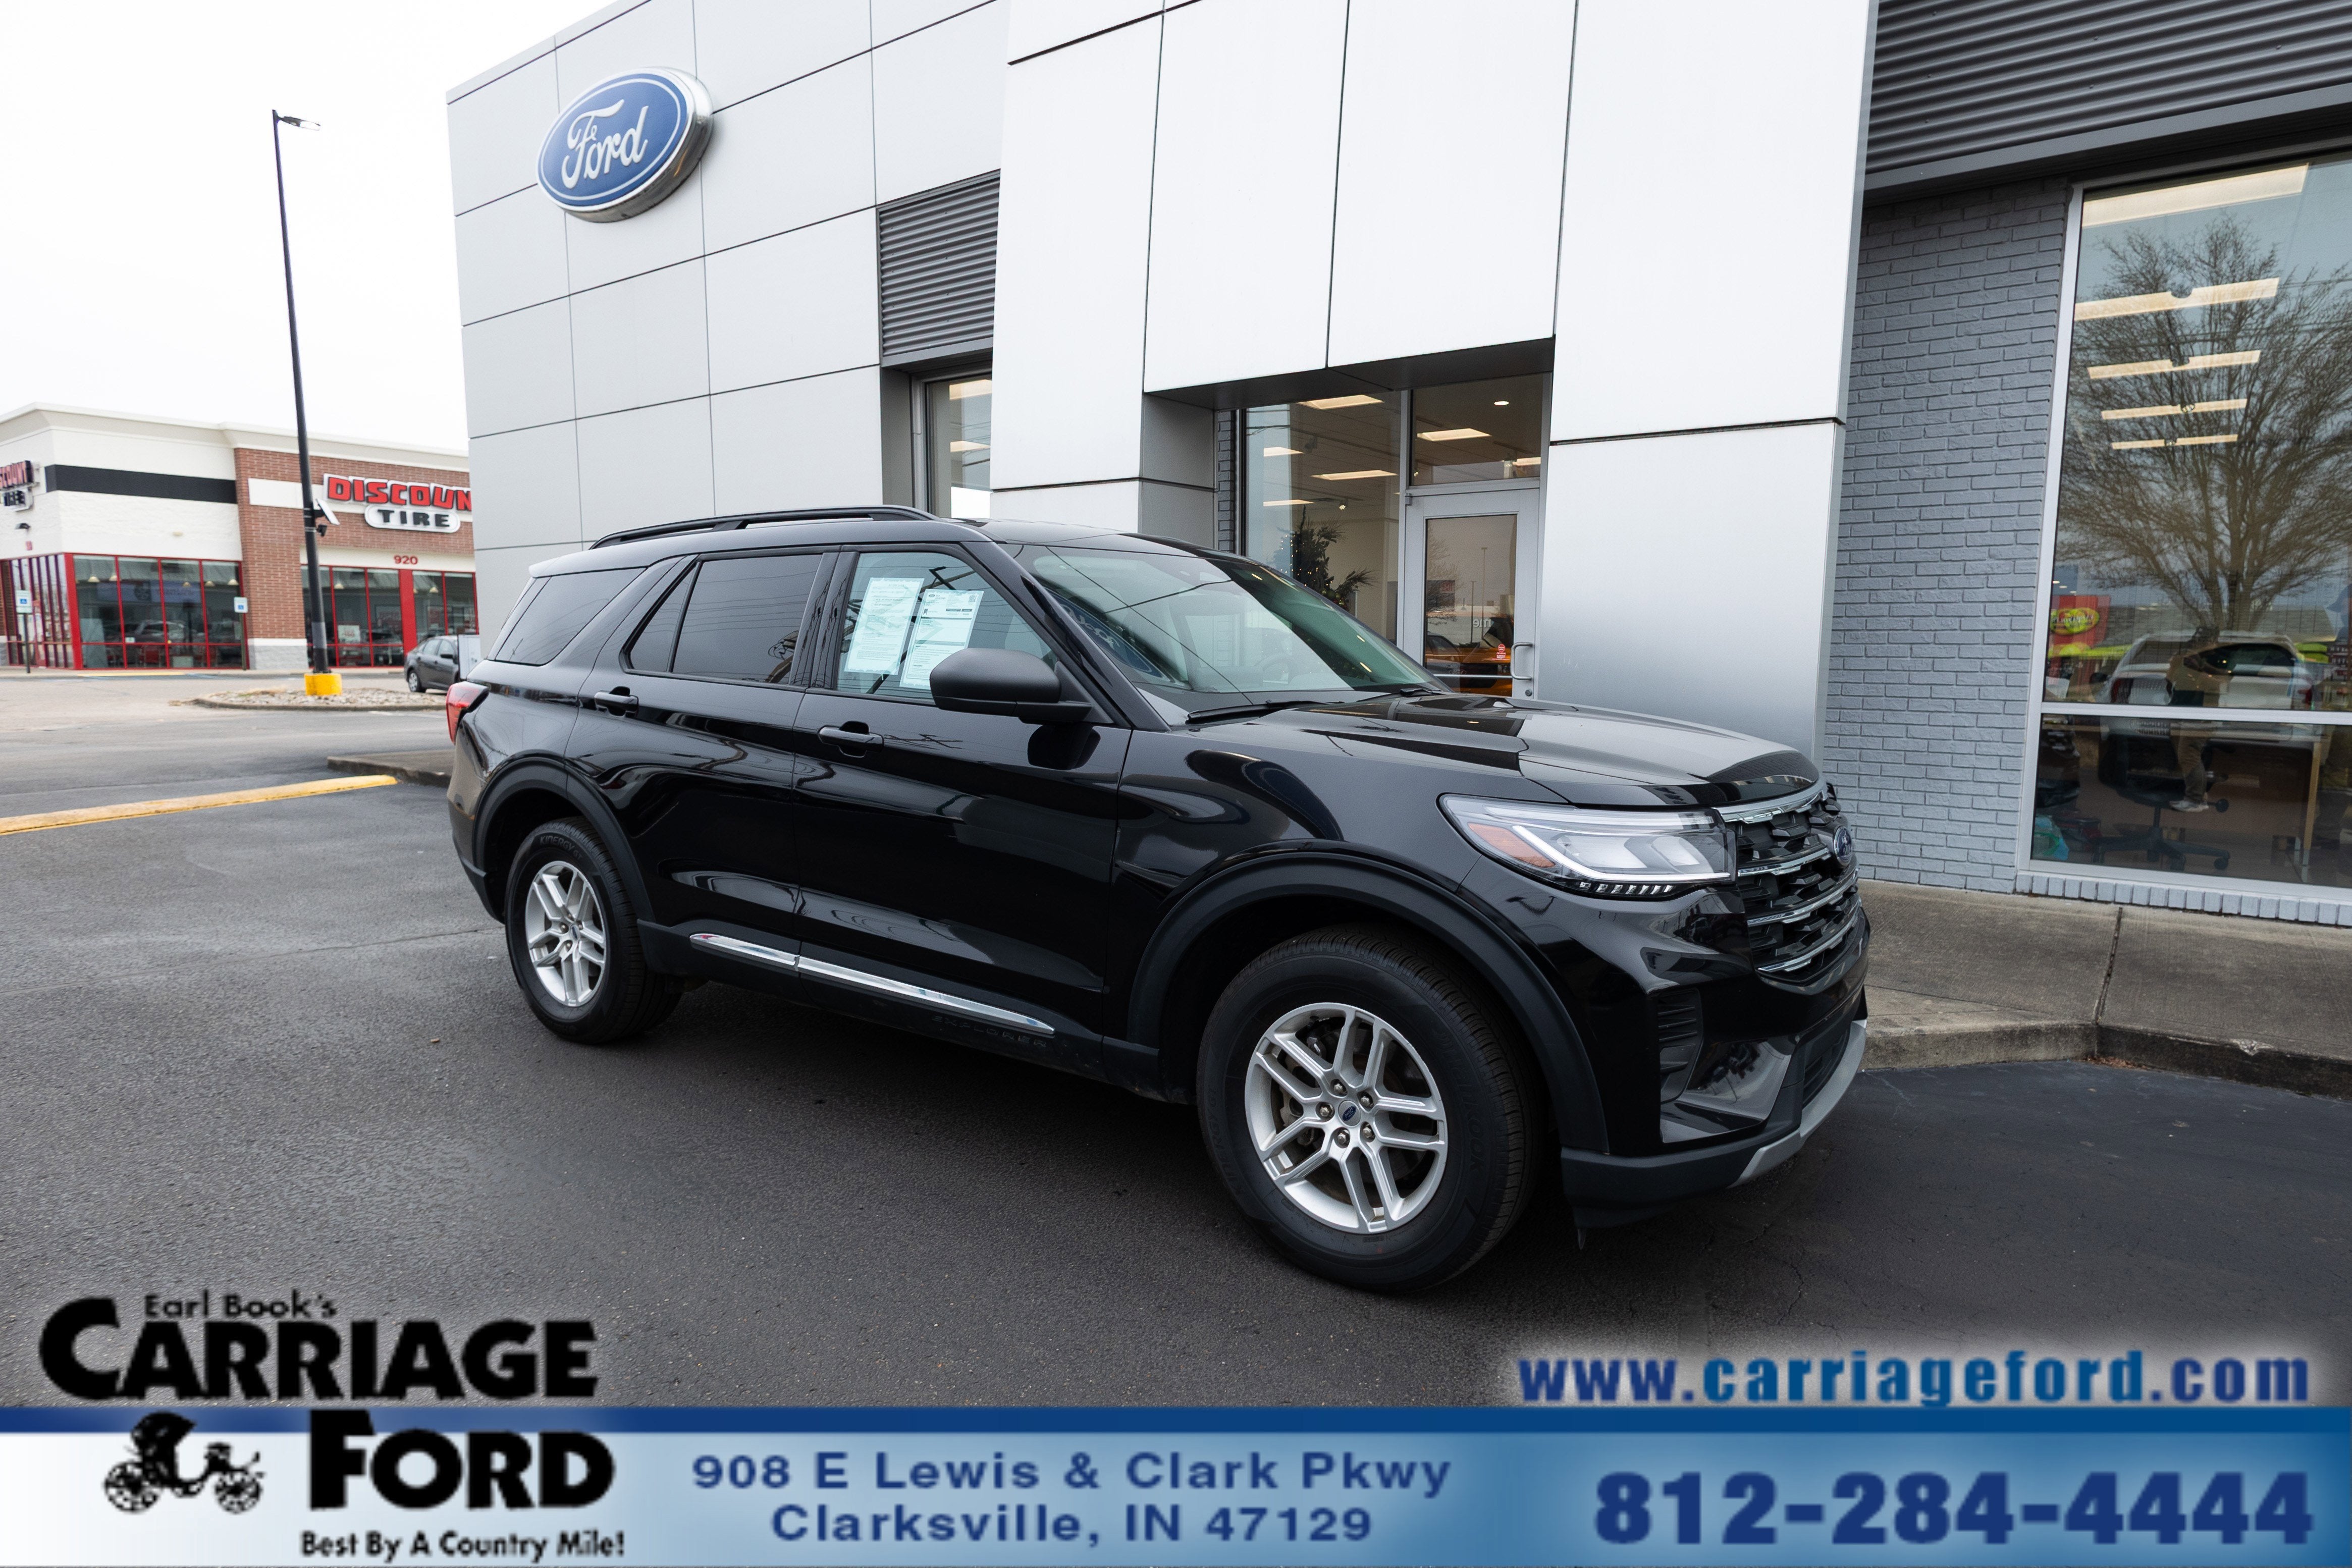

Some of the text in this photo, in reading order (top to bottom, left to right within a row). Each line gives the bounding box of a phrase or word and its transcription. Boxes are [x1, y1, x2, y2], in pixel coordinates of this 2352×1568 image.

[561, 98, 649, 189] Ford
[328, 477, 472, 512] DISCOUN
[377, 509, 450, 527] TIRE
[393, 555, 418, 565] 920
[932, 1015, 1047, 1048] EXPLORER
